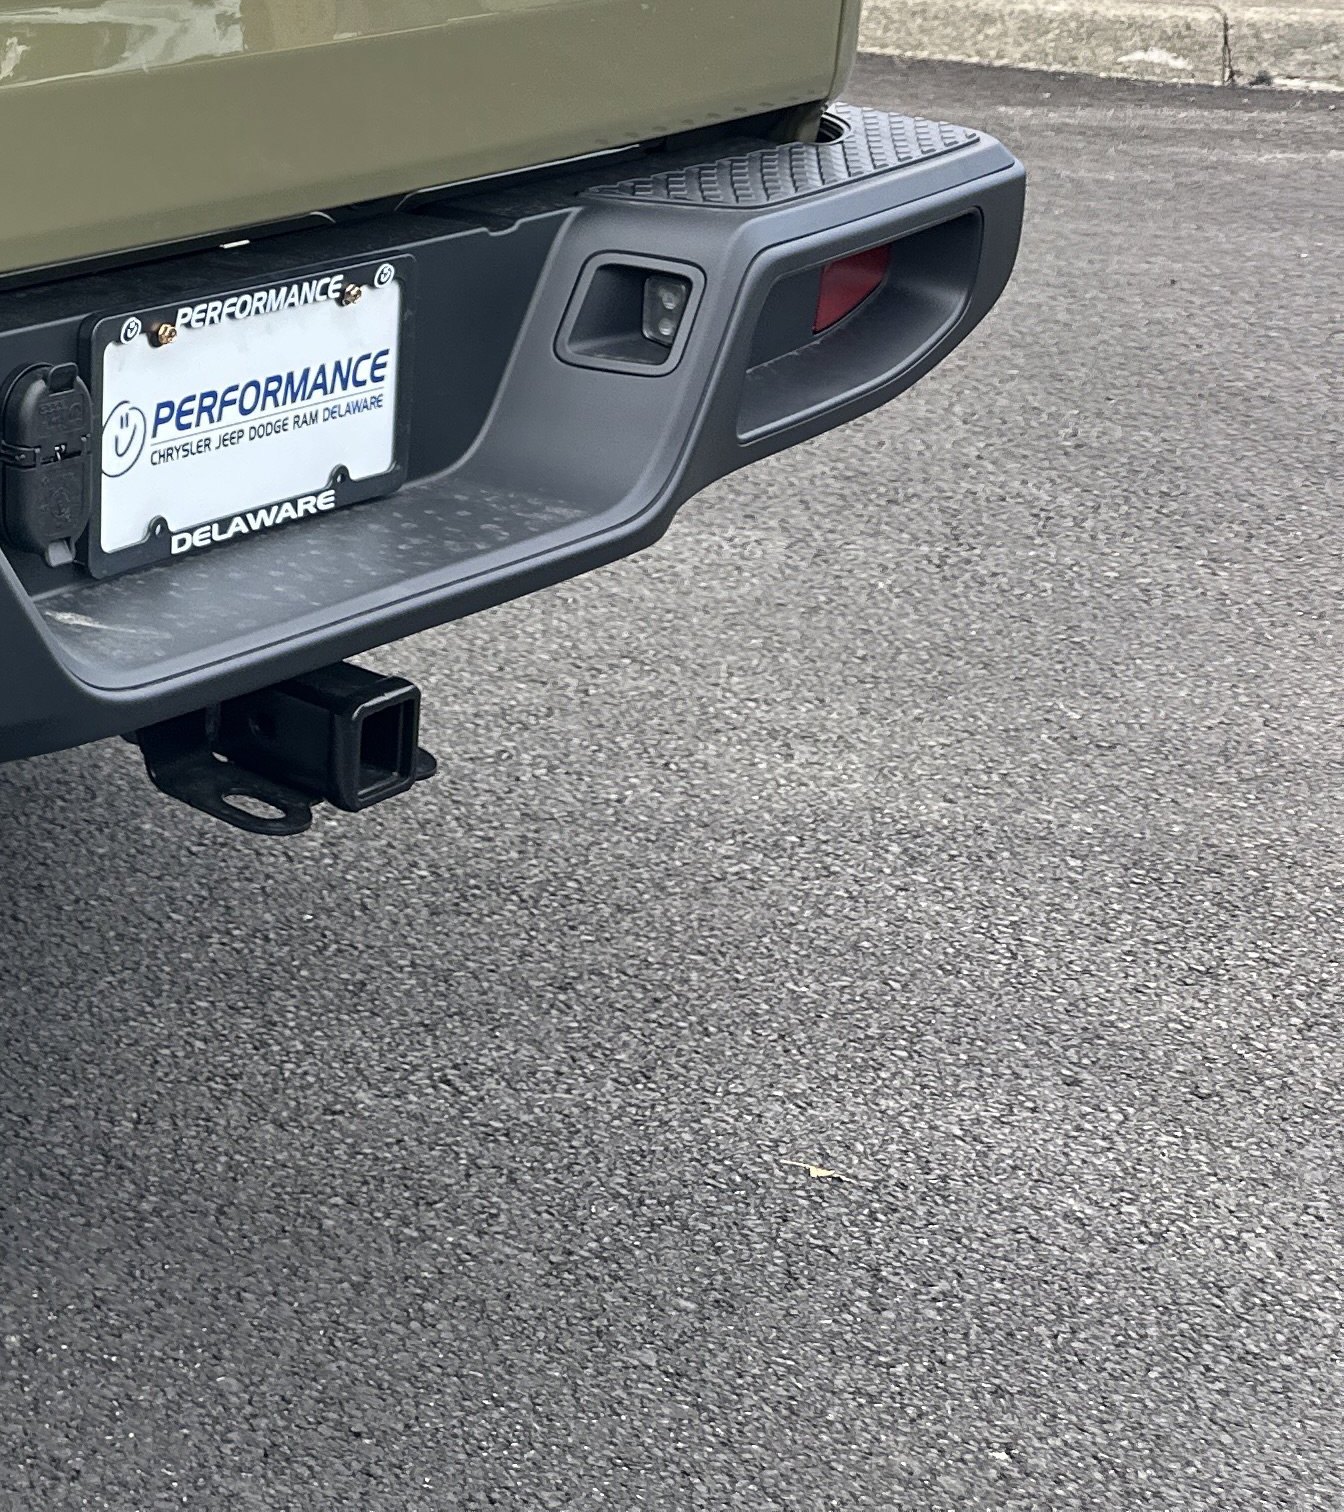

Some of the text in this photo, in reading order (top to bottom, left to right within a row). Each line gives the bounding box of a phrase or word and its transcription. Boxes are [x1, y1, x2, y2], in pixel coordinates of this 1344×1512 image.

[174, 274, 344, 330] PERFORMANCE
[150, 348, 391, 439] PERFORMANCE
[150, 393, 384, 467] CHRYSLER JEEP DODGE RAM DELAWARE
[170, 489, 336, 555] DELAWARE
